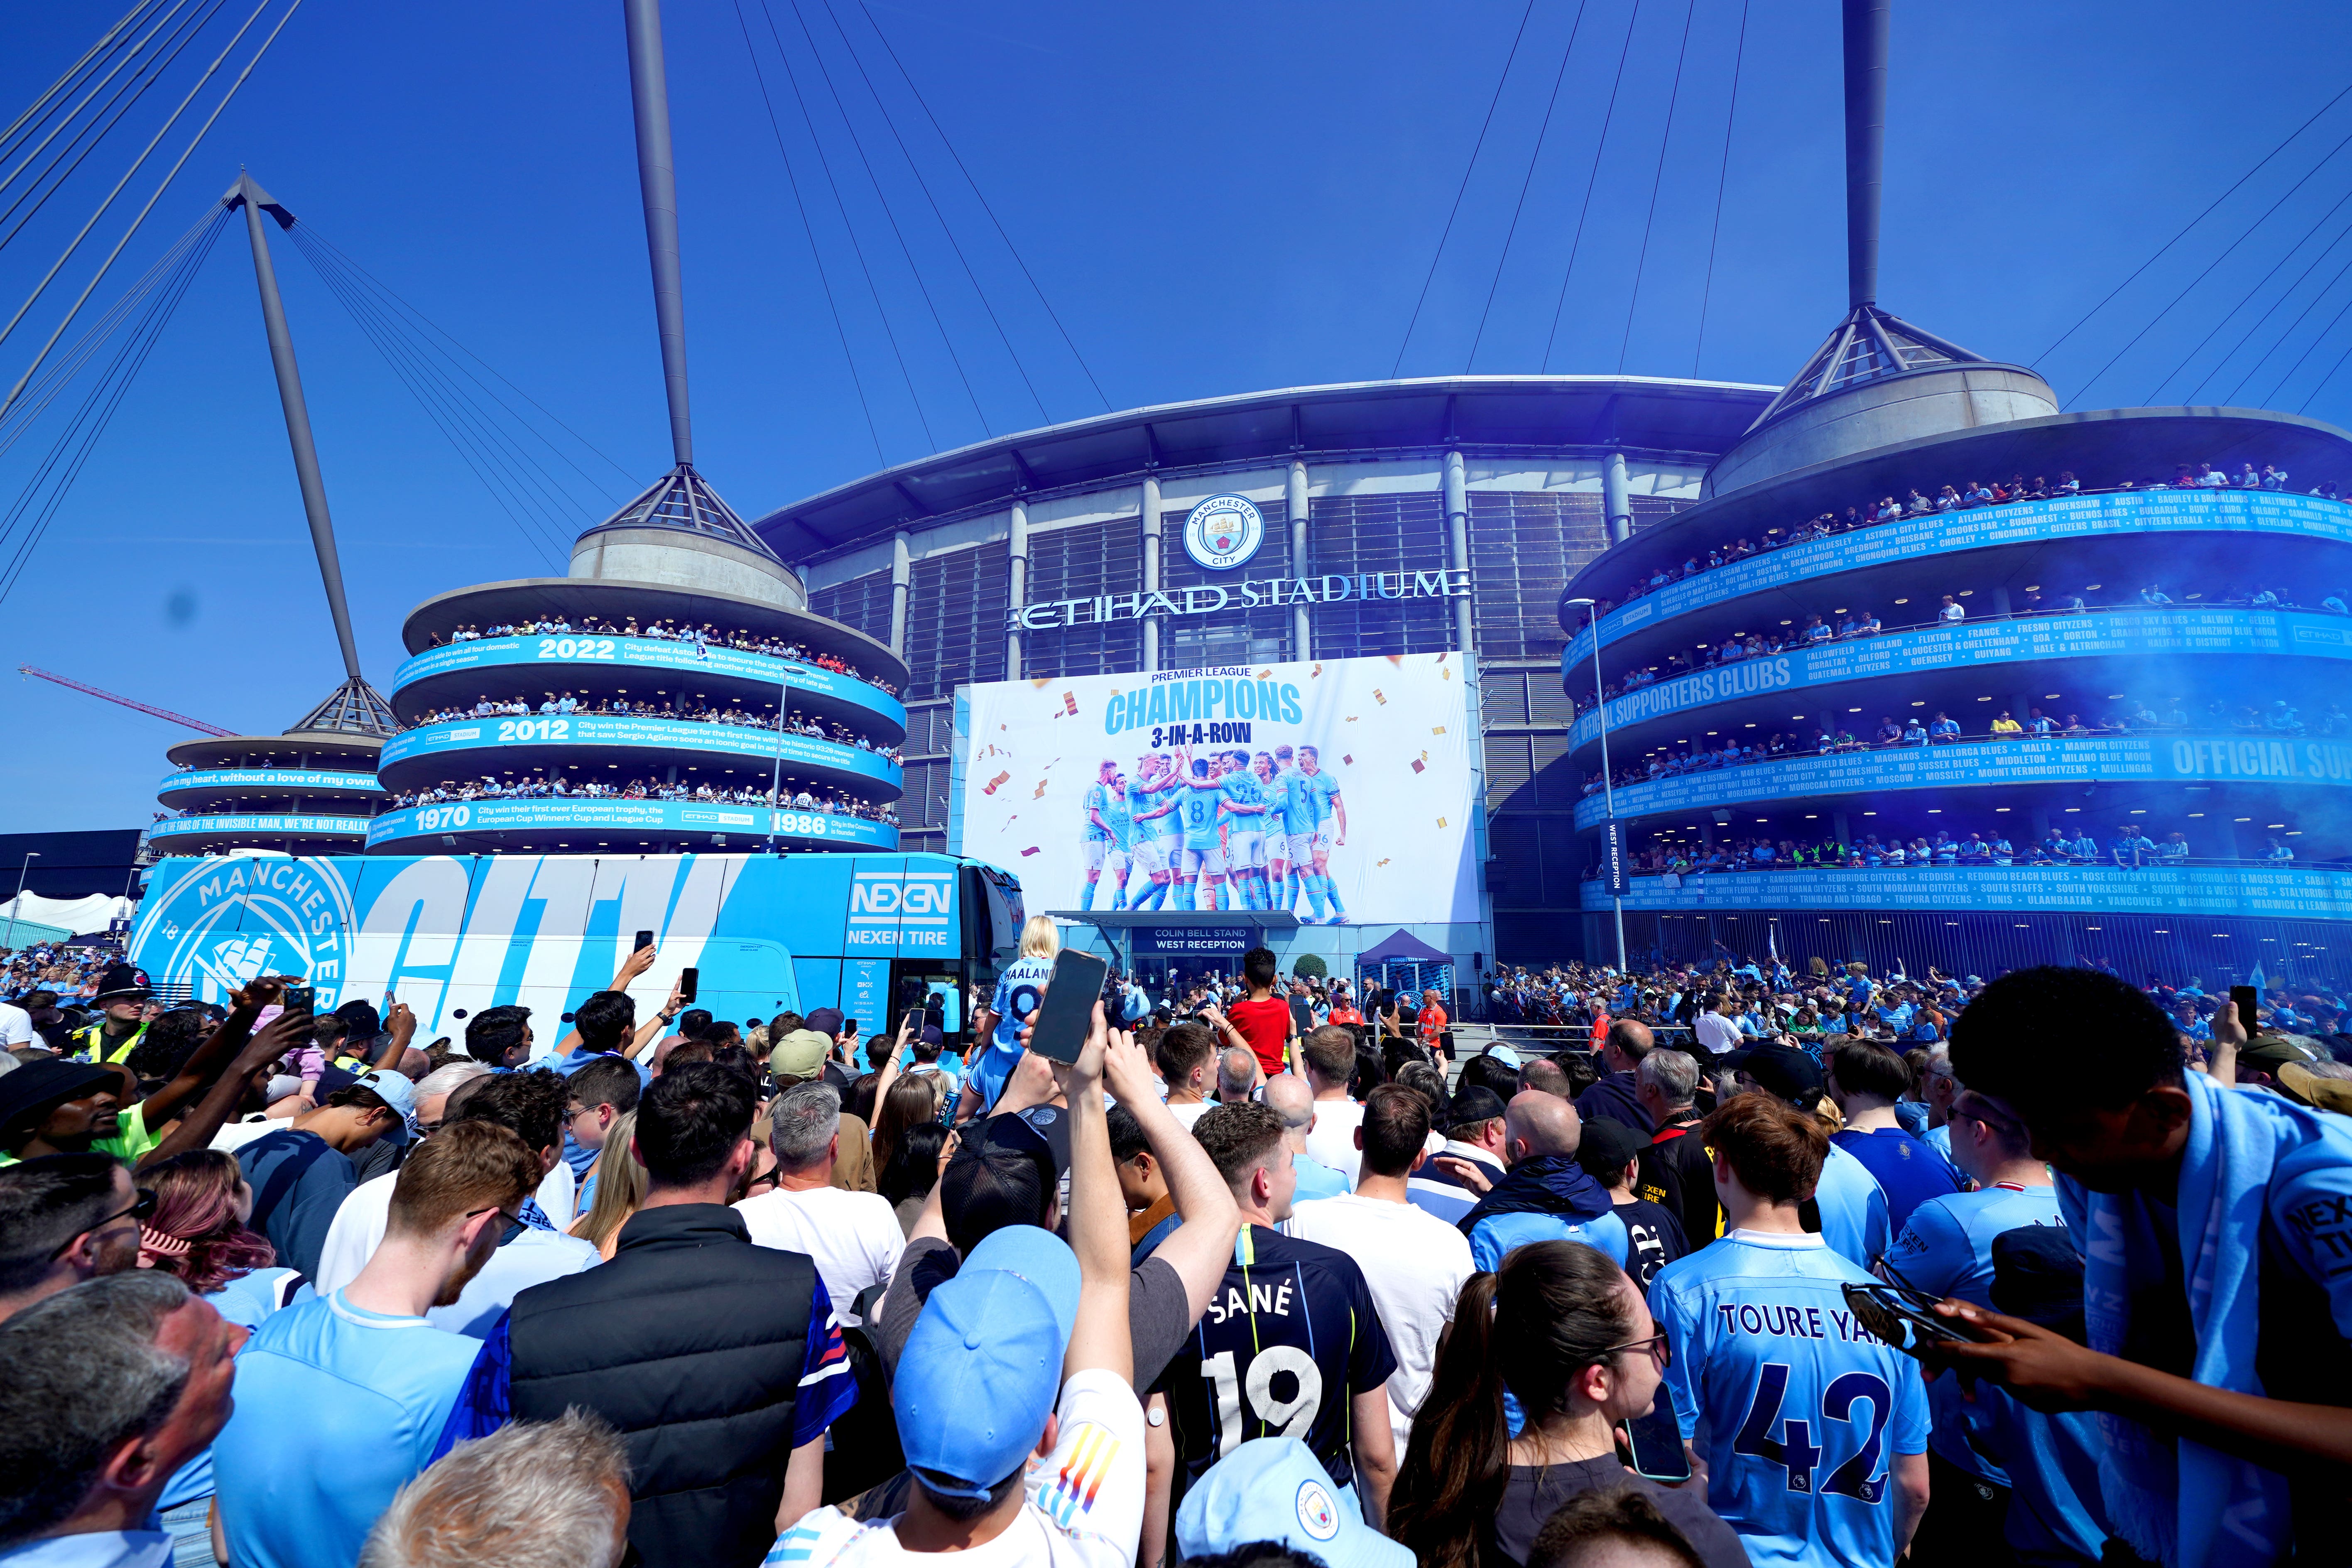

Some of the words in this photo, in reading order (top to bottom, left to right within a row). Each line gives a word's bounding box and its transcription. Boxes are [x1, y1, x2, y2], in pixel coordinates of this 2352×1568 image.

[1192, 500, 1254, 524] MANCHESTER
[1782, 548, 1806, 560] ASTLEY
[1815, 538, 1852, 551] TYLDESLEY
[1865, 527, 1897, 541] ASTORIA
[1899, 522, 1917, 534] CITY
[1919, 520, 1943, 531] BLUES
[1958, 510, 1993, 523] ATLANTA
[1996, 506, 2034, 518] CITYZENS
[2049, 499, 2100, 512] AUDENSHAW
[1021, 585, 1228, 630] ETIHAD
[1241, 568, 1451, 609] STADIUM
[1602, 620, 1621, 634] ETIHAD
[1626, 608, 1648, 622] STADIUM
[1807, 646, 1855, 661] FALLOWFIELD
[1870, 639, 1902, 650] FINLAND
[1918, 632, 1950, 644] FLIXTON
[1968, 627, 2000, 637] FRANCE
[2017, 622, 2050, 632] FRESNO
[2053, 620, 2092, 630] CITYZENS
[2299, 631, 2340, 640] ETIHAD
[538, 639, 615, 659] 2022
[1152, 669, 1202, 683] PREMIER
[1206, 668, 1251, 677] LEAGUE
[1105, 679, 1302, 735] CHAMPIONS
[1580, 706, 1615, 741] OFFICAL
[1616, 674, 1715, 724] SUPPORTERS
[1719, 658, 1790, 696] CLUBS
[499, 720, 568, 740] 2012
[1151, 722, 1251, 748] 3-IN-A-ROW
[2173, 740, 2304, 776] OFFICIAL
[180, 777, 190, 786] my
[193, 774, 218, 783] heart,
[220, 773, 265, 782] without
[278, 773, 304, 782] love
[323, 777, 343, 786] my
[1773, 774, 1798, 783] MEXICO
[1801, 772, 1815, 781] CITY
[1830, 769, 1844, 778] MID
[1847, 767, 1884, 776] CHESHIRE
[1899, 763, 1915, 772] MID
[1918, 760, 1950, 770] SUSSEX
[1953, 759, 1979, 767] BLUES
[1236, 782, 1262, 804] 26
[1300, 780, 1307, 803] 5
[415, 806, 470, 831] 1970
[478, 806, 494, 815] City
[572, 805, 614, 813] European
[616, 806, 647, 815] trophy,
[478, 816, 514, 824] European
[1191, 800, 1204, 823] 8
[177, 820, 191, 831] FANS
[192, 819, 200, 829] OF
[203, 819, 214, 829] THE
[216, 818, 256, 828] INVISIBLE
[258, 818, 282, 830] MAN,
[284, 818, 314, 829] WE'RE
[316, 819, 333, 829] NOT
[336, 820, 369, 831] REALLY
[769, 813, 826, 835] 1986
[831, 820, 842, 829] City
[855, 824, 876, 833] Community
[1611, 847, 1620, 888] RECEPTION
[1828, 874, 1869, 882] REDBRIDGE
[1870, 873, 1906, 881] CITYZENS
[1919, 872, 1955, 881] REDDISH
[1967, 872, 2007, 881] REDONDO
[2010, 872, 2039, 881] BEACH
[2042, 872, 2069, 881] BLUES
[851, 884, 951, 913] NEXEN
[116, 921, 124, 930] X
[162, 919, 179, 940] 18
[199, 862, 338, 1009] MANCHESTER
[848, 931, 903, 944] NEXEN
[909, 932, 947, 945] TIRE
[343, 855, 751, 1051] CITY
[1005, 968, 1051, 982] HAALAN
[1643, 1184, 1666, 1197] EXEN
[2286, 1196, 2352, 1236] NEX
[1904, 1225, 1928, 1252] EXEN
[1208, 1279, 1293, 1323] SANÉ
[1718, 1303, 1824, 1340] TOURE
[1829, 1308, 1899, 1350] YAY
[1200, 1345, 1323, 1458] 19
[1733, 1362, 1891, 1504] 42
